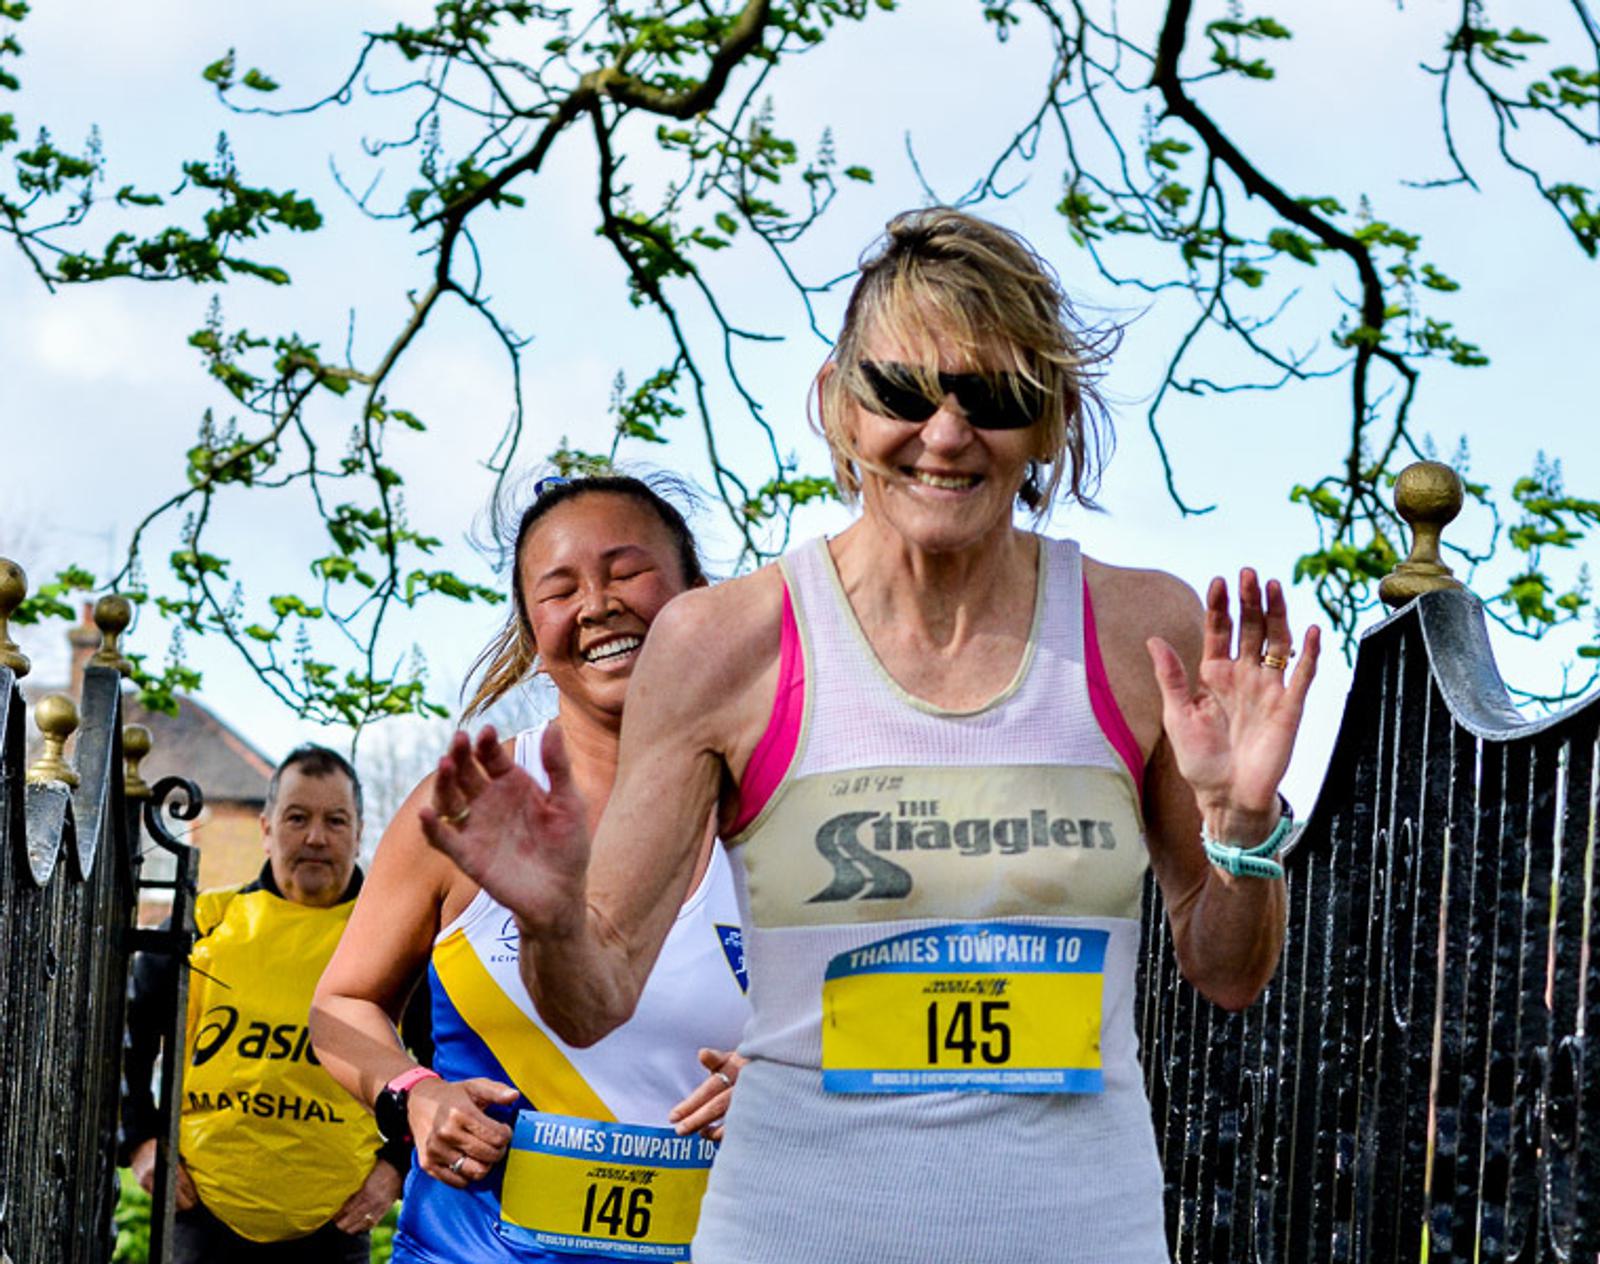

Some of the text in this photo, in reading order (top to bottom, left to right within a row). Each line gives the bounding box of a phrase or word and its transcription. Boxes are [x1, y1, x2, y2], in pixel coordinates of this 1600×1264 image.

[897, 800, 941, 816] THE
[804, 809, 1117, 904] Stragglers
[850, 934, 1081, 968] THAMES TOWPATH 10
[927, 1001, 1012, 1065] 145
[188, 1091, 346, 1123] MARSHAL
[533, 1121, 715, 1161] THAMES TOWPATH 10
[581, 1183, 654, 1239] 146
